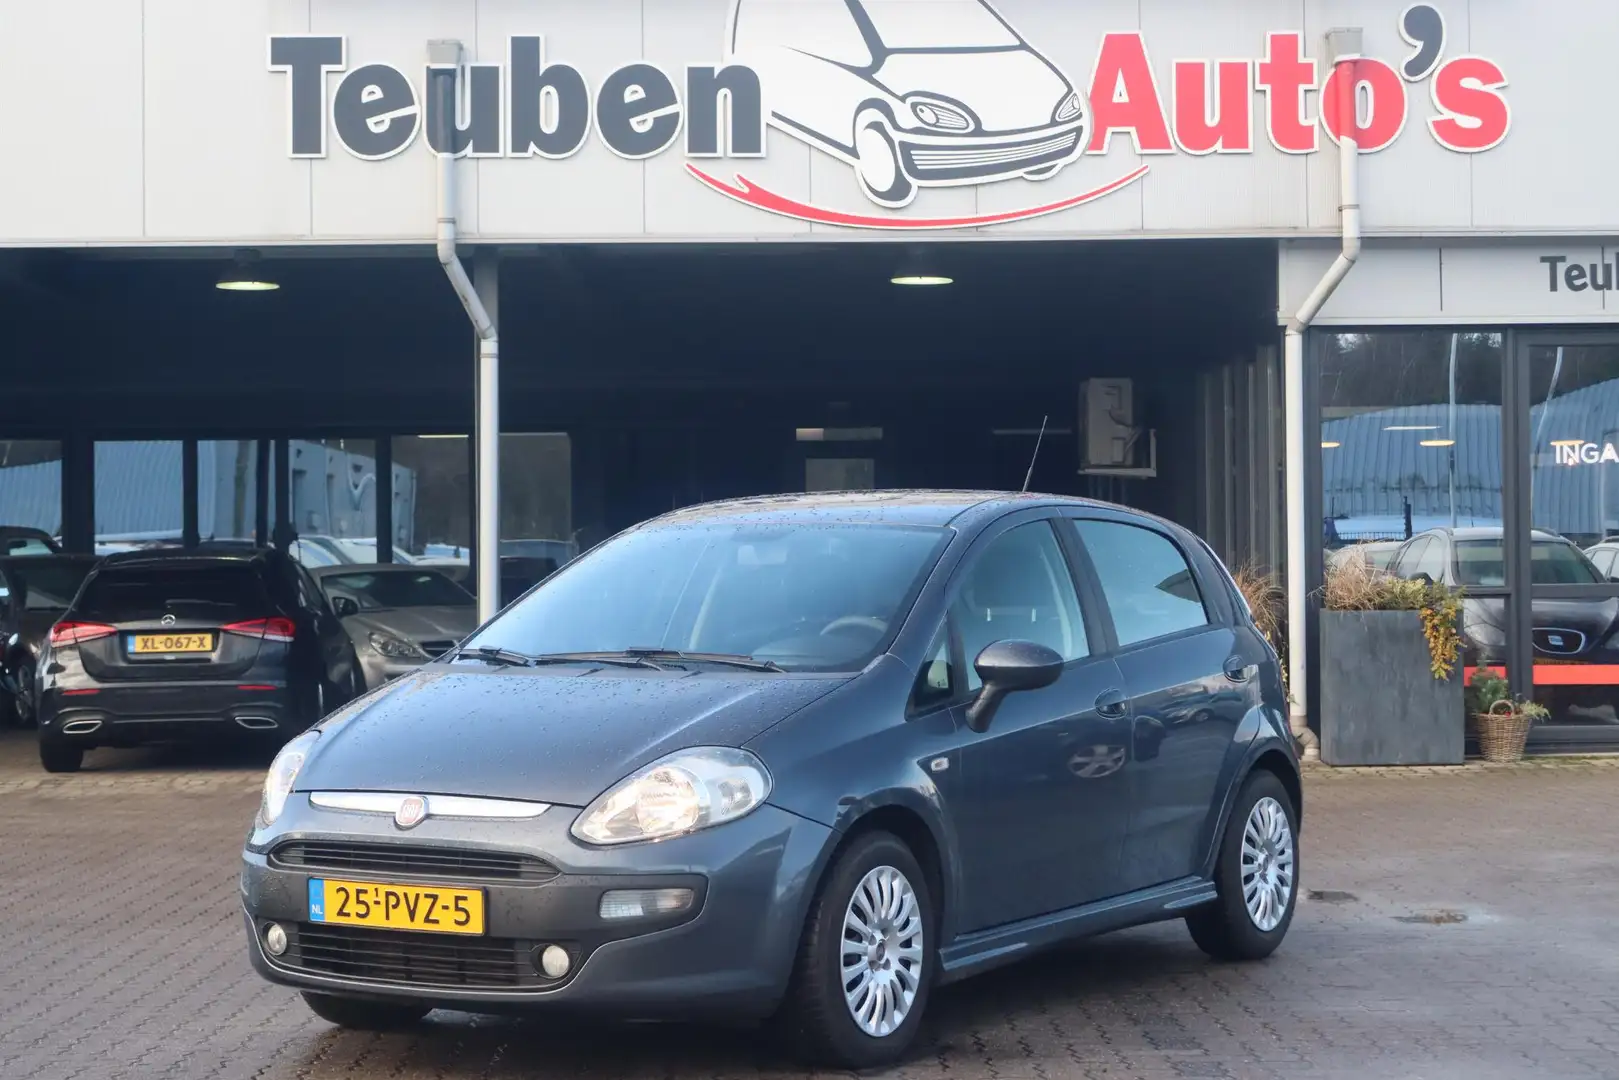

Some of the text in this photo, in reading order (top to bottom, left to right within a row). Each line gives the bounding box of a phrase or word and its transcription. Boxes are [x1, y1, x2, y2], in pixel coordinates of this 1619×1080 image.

[269, 4, 1512, 160] Teuben Auto's
[1540, 252, 1619, 292] Teu
[141, 636, 206, 650] XL-067-X
[311, 904, 323, 915] NL
